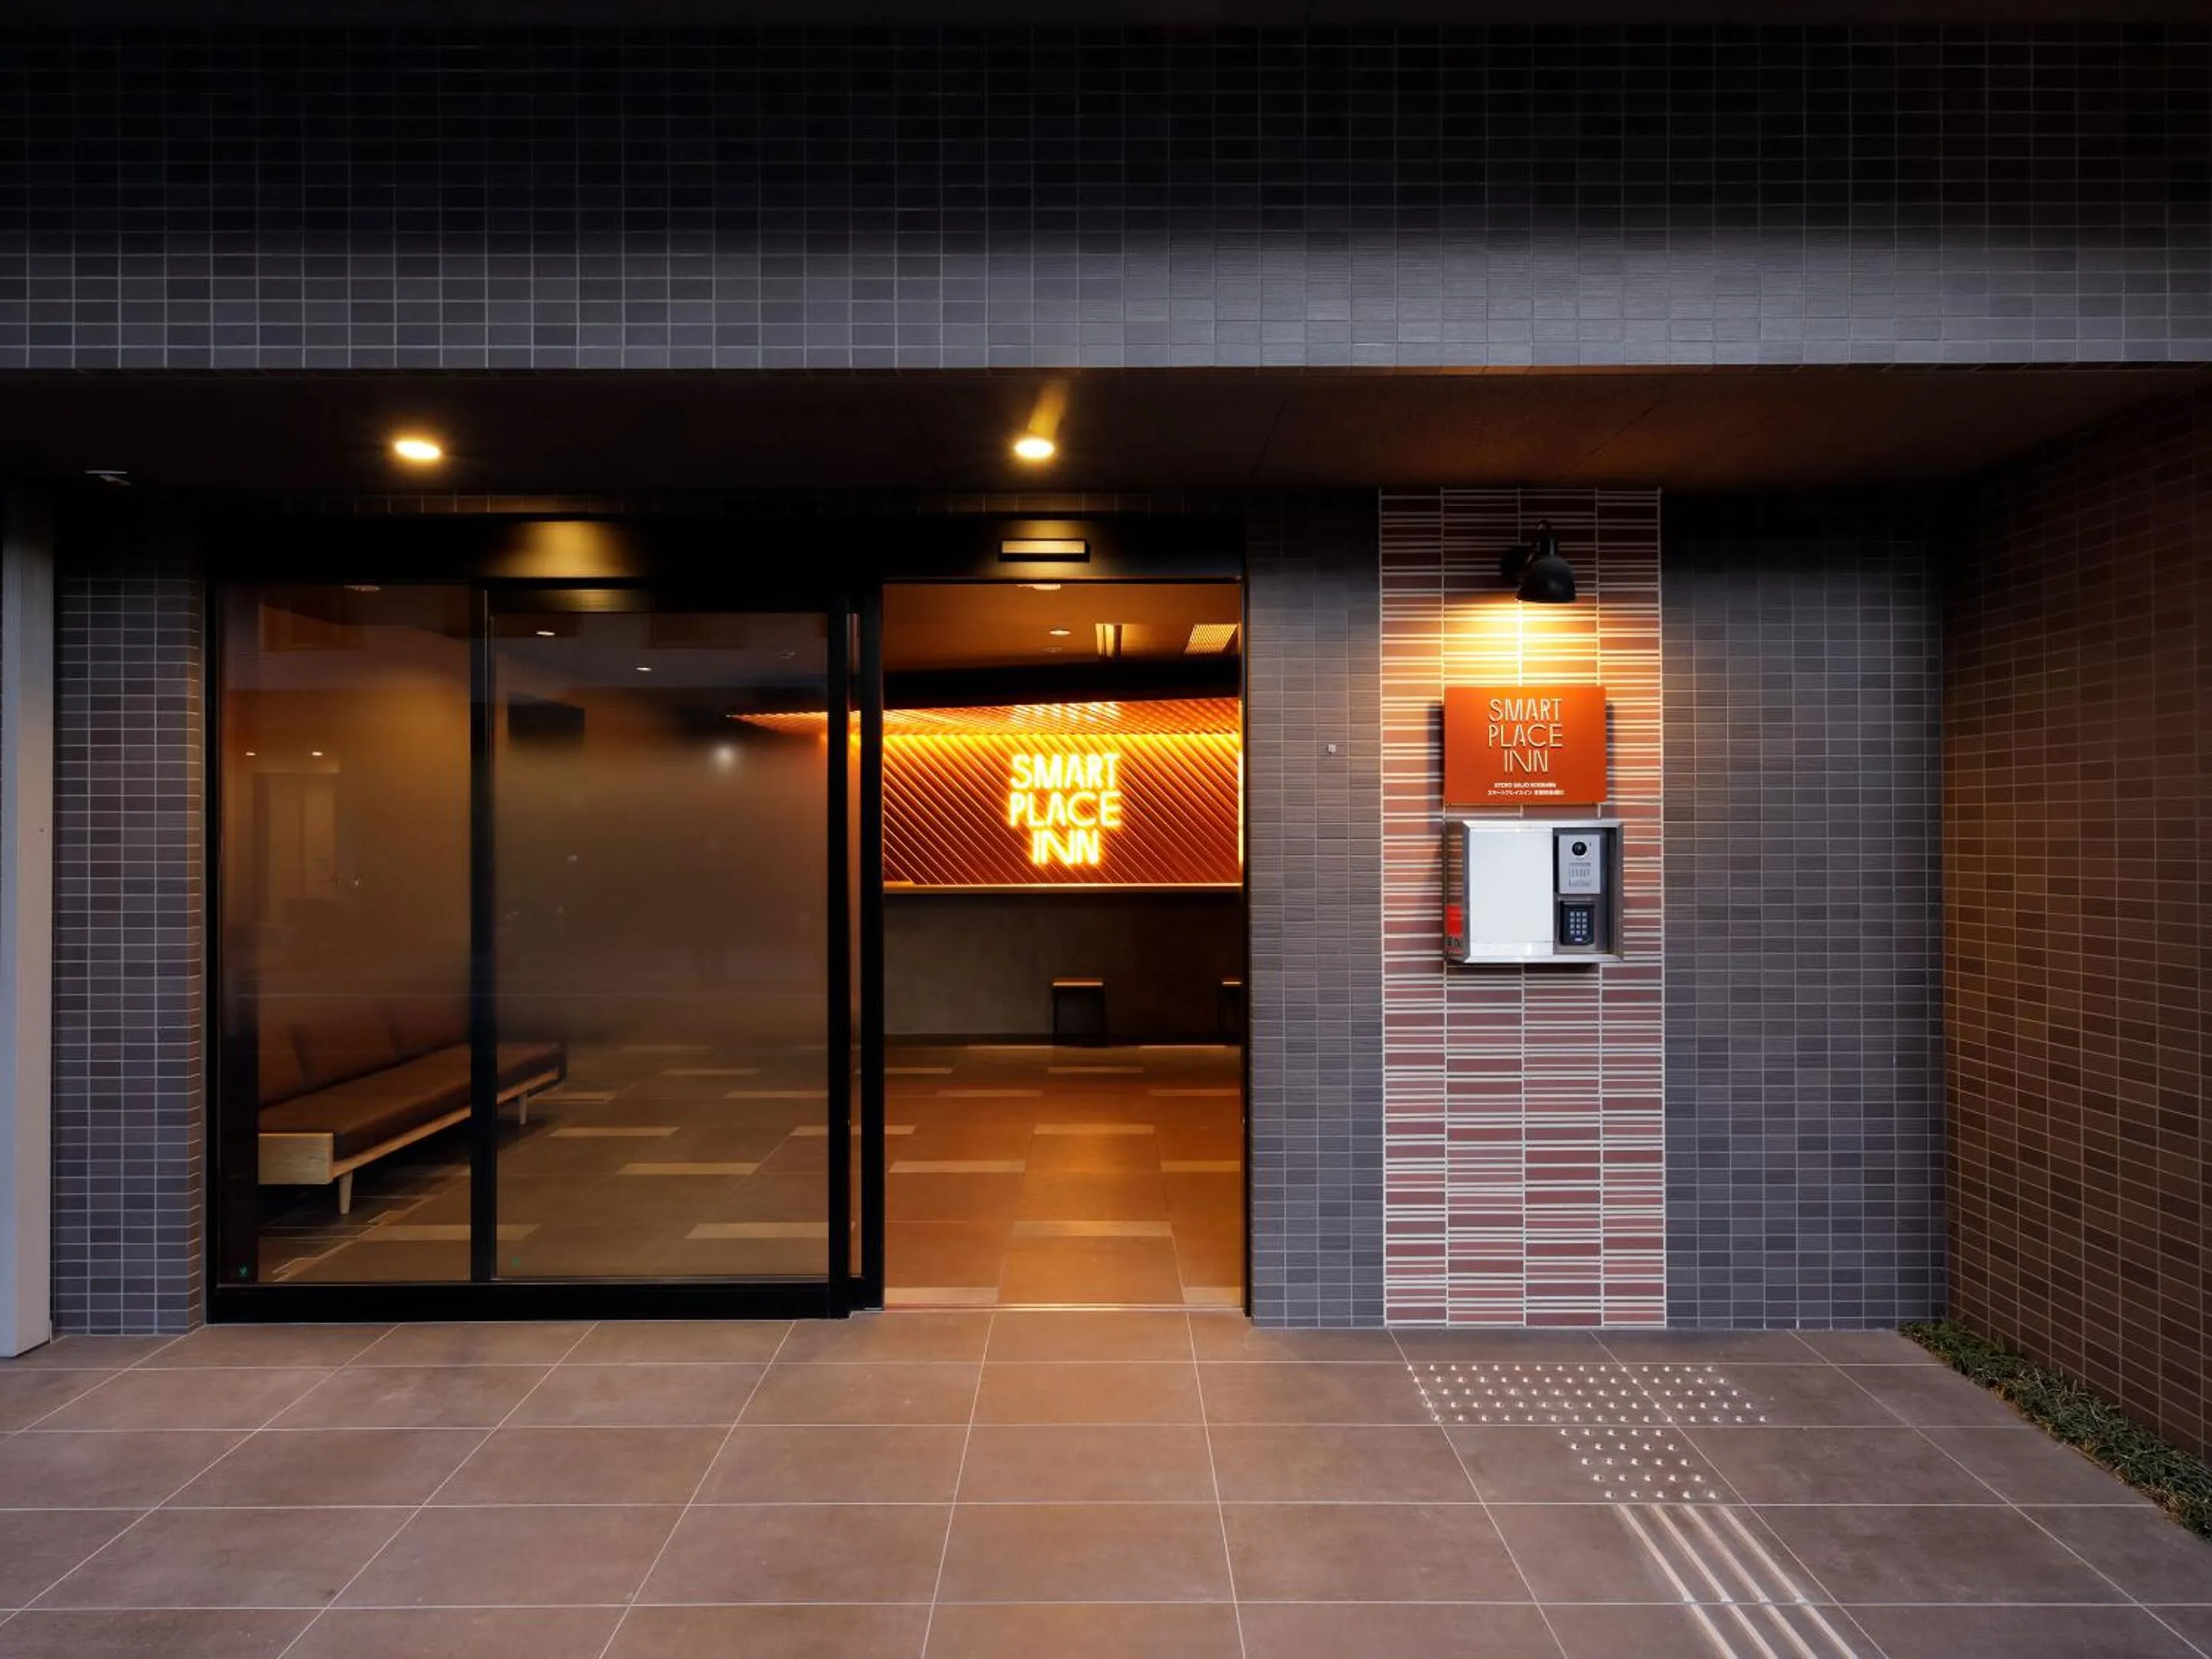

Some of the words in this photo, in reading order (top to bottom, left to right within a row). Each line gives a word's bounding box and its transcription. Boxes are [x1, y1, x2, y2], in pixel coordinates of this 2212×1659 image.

[1488, 698, 1562, 722] SMART
[1488, 724, 1564, 747] PLACE
[1010, 753, 1121, 790] SMART
[1503, 749, 1549, 772] INN
[1009, 791, 1122, 827] PLACE
[1031, 829, 1100, 865] INN
